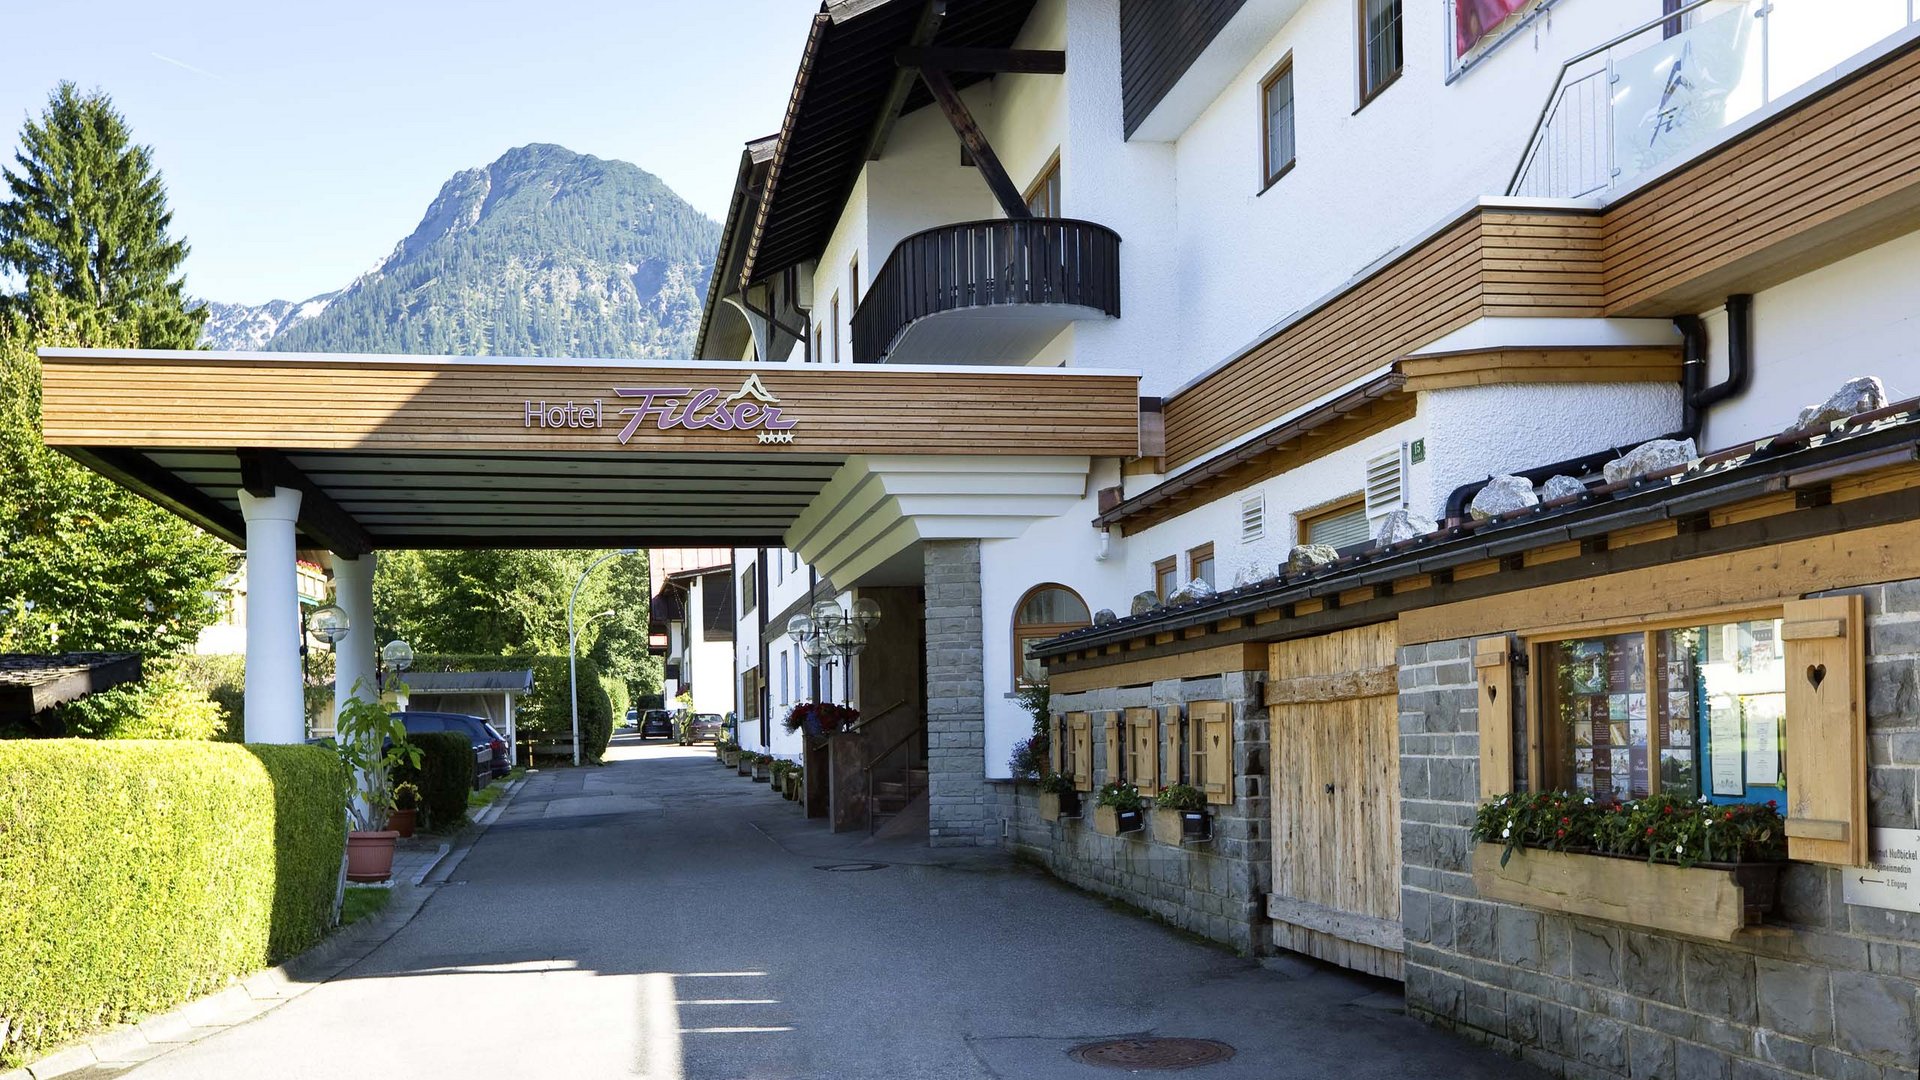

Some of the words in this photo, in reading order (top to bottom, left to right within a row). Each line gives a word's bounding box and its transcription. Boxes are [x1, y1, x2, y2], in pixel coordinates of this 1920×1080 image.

[524, 399, 603, 428] Hotel
[612, 386, 800, 445] Filser
[1414, 442, 1421, 454] 15
